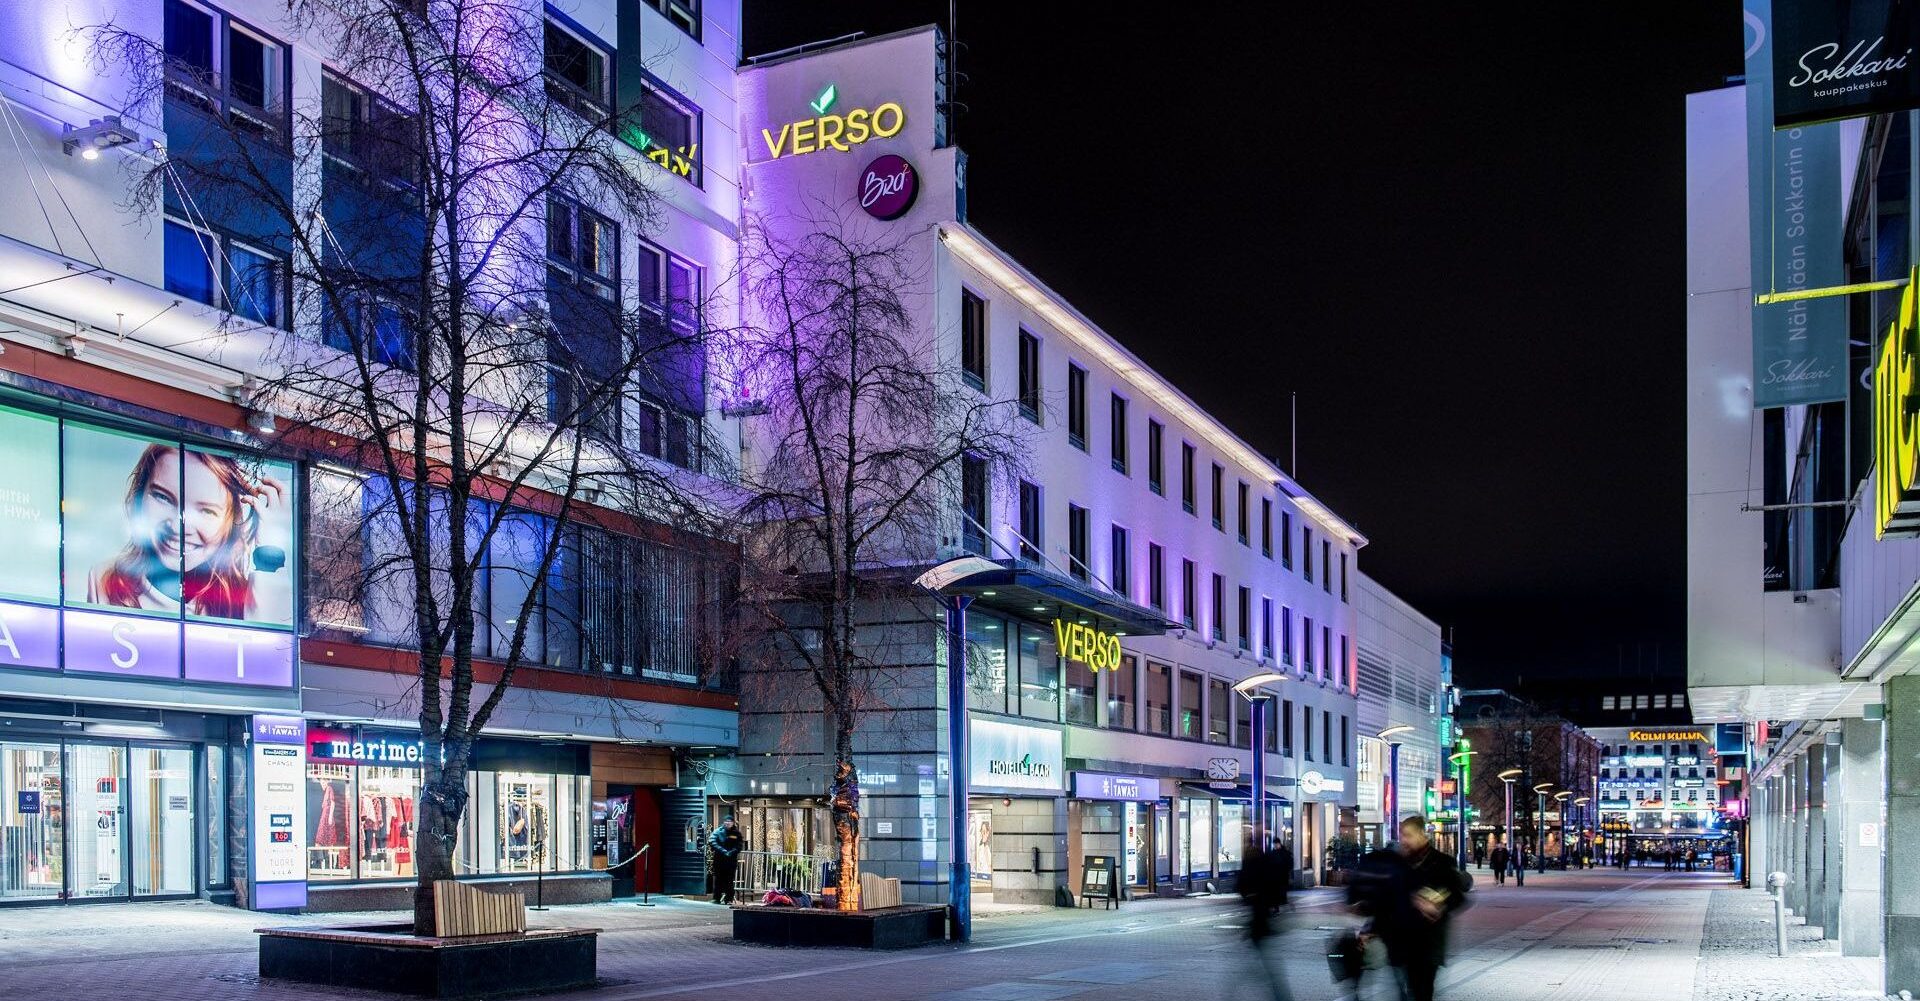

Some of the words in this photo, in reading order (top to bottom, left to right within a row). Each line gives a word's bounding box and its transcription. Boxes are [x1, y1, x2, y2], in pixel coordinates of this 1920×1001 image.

[1789, 36, 1913, 88] Sokkari
[1813, 79, 1888, 98] kauppakeskus
[761, 101, 906, 160] VERSO
[1785, 147, 1805, 237] Sokkarin
[1762, 357, 1835, 386] Sokkari
[1053, 618, 1122, 673] VERSO
[271, 727, 302, 737] TAWAST
[1113, 784, 1139, 798] TAWAST
